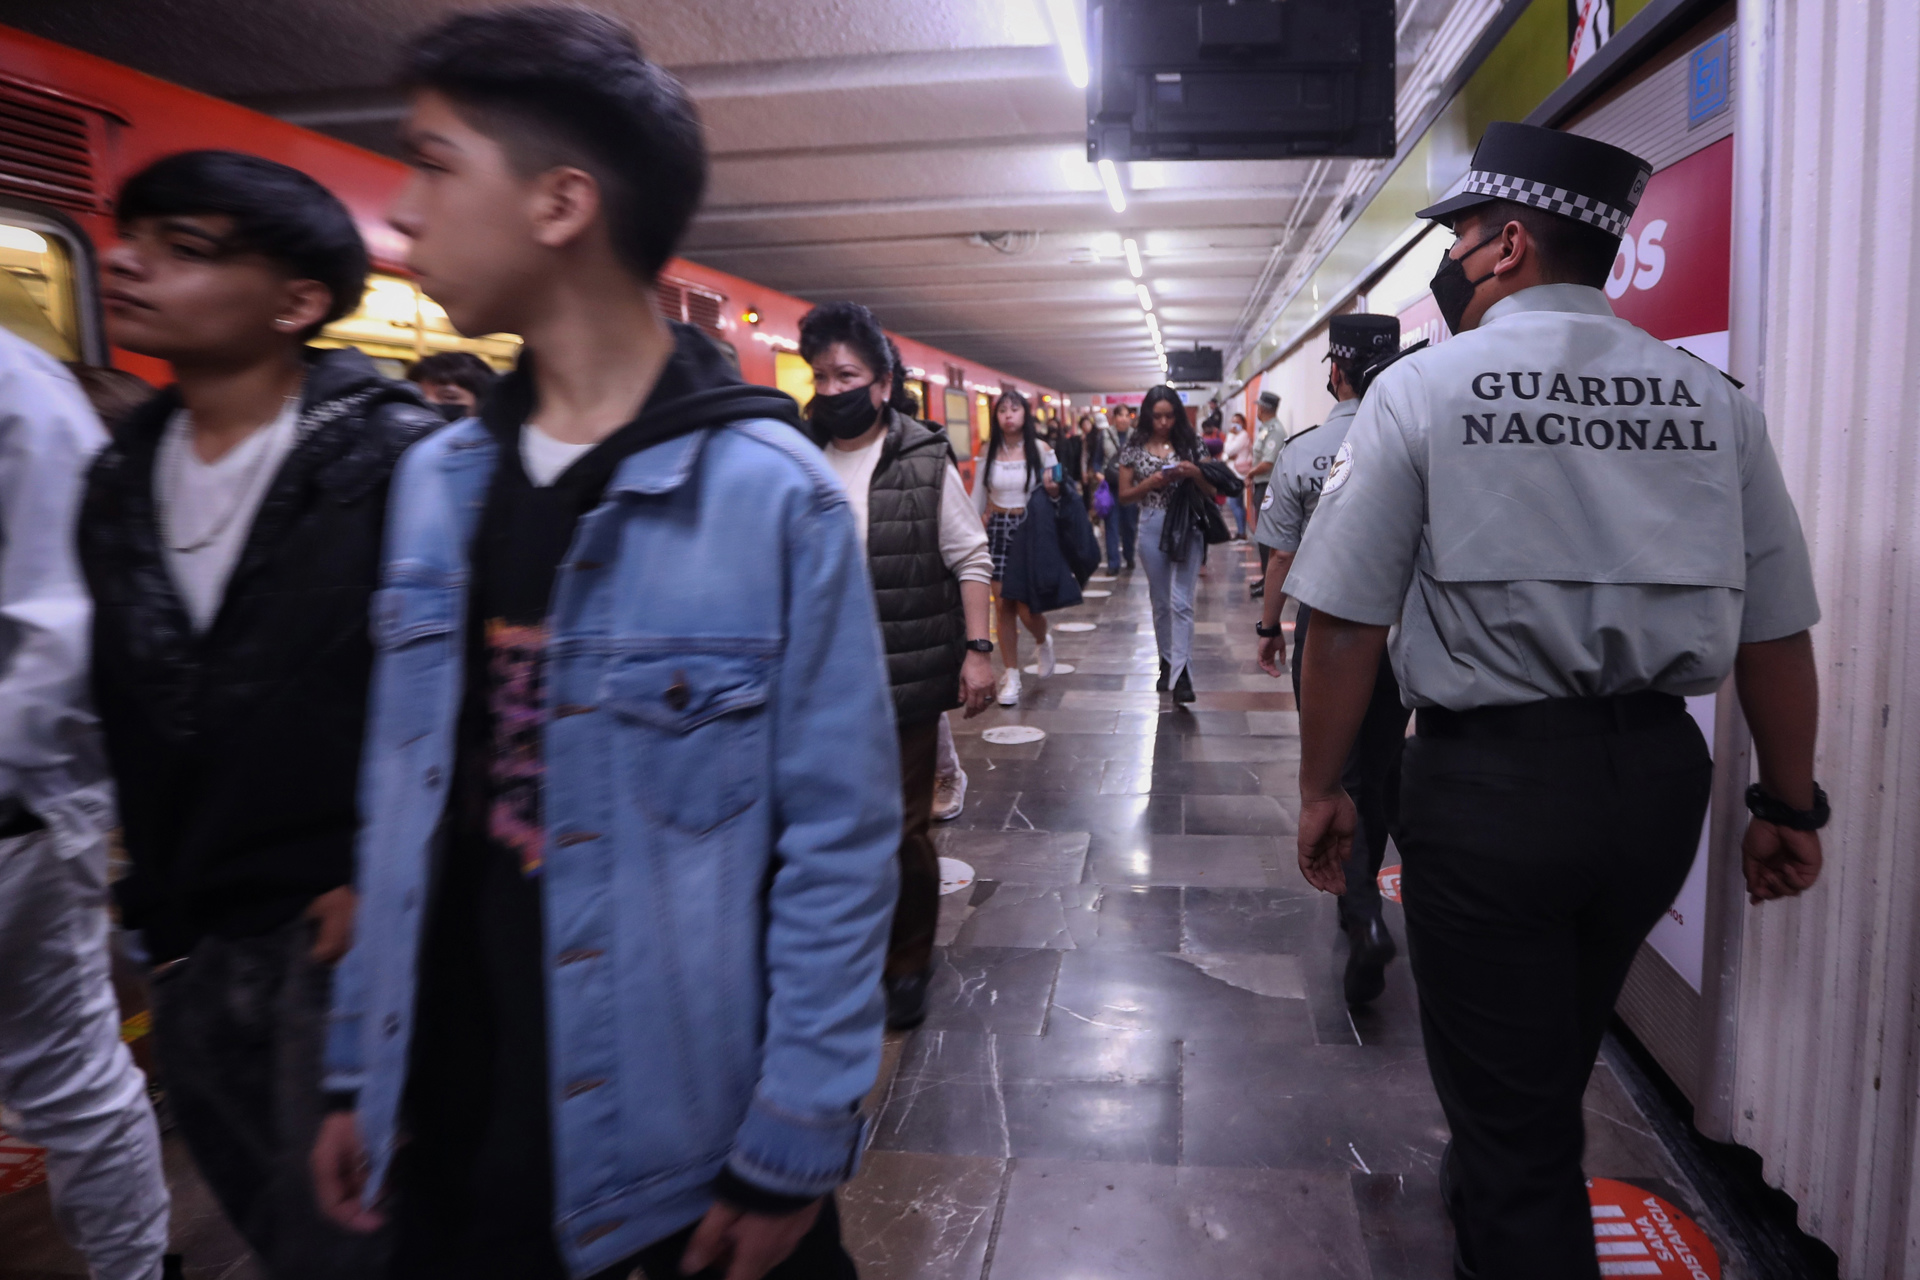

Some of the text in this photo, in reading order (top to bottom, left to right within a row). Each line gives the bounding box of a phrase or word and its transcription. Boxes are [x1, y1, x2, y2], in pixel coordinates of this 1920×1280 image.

[1471, 372, 1701, 407] GUARDIA
[1462, 413, 1717, 451] NACIONAL
[1635, 1216, 1674, 1262] SANA
[1643, 1197, 1711, 1280] DISTANCIA
